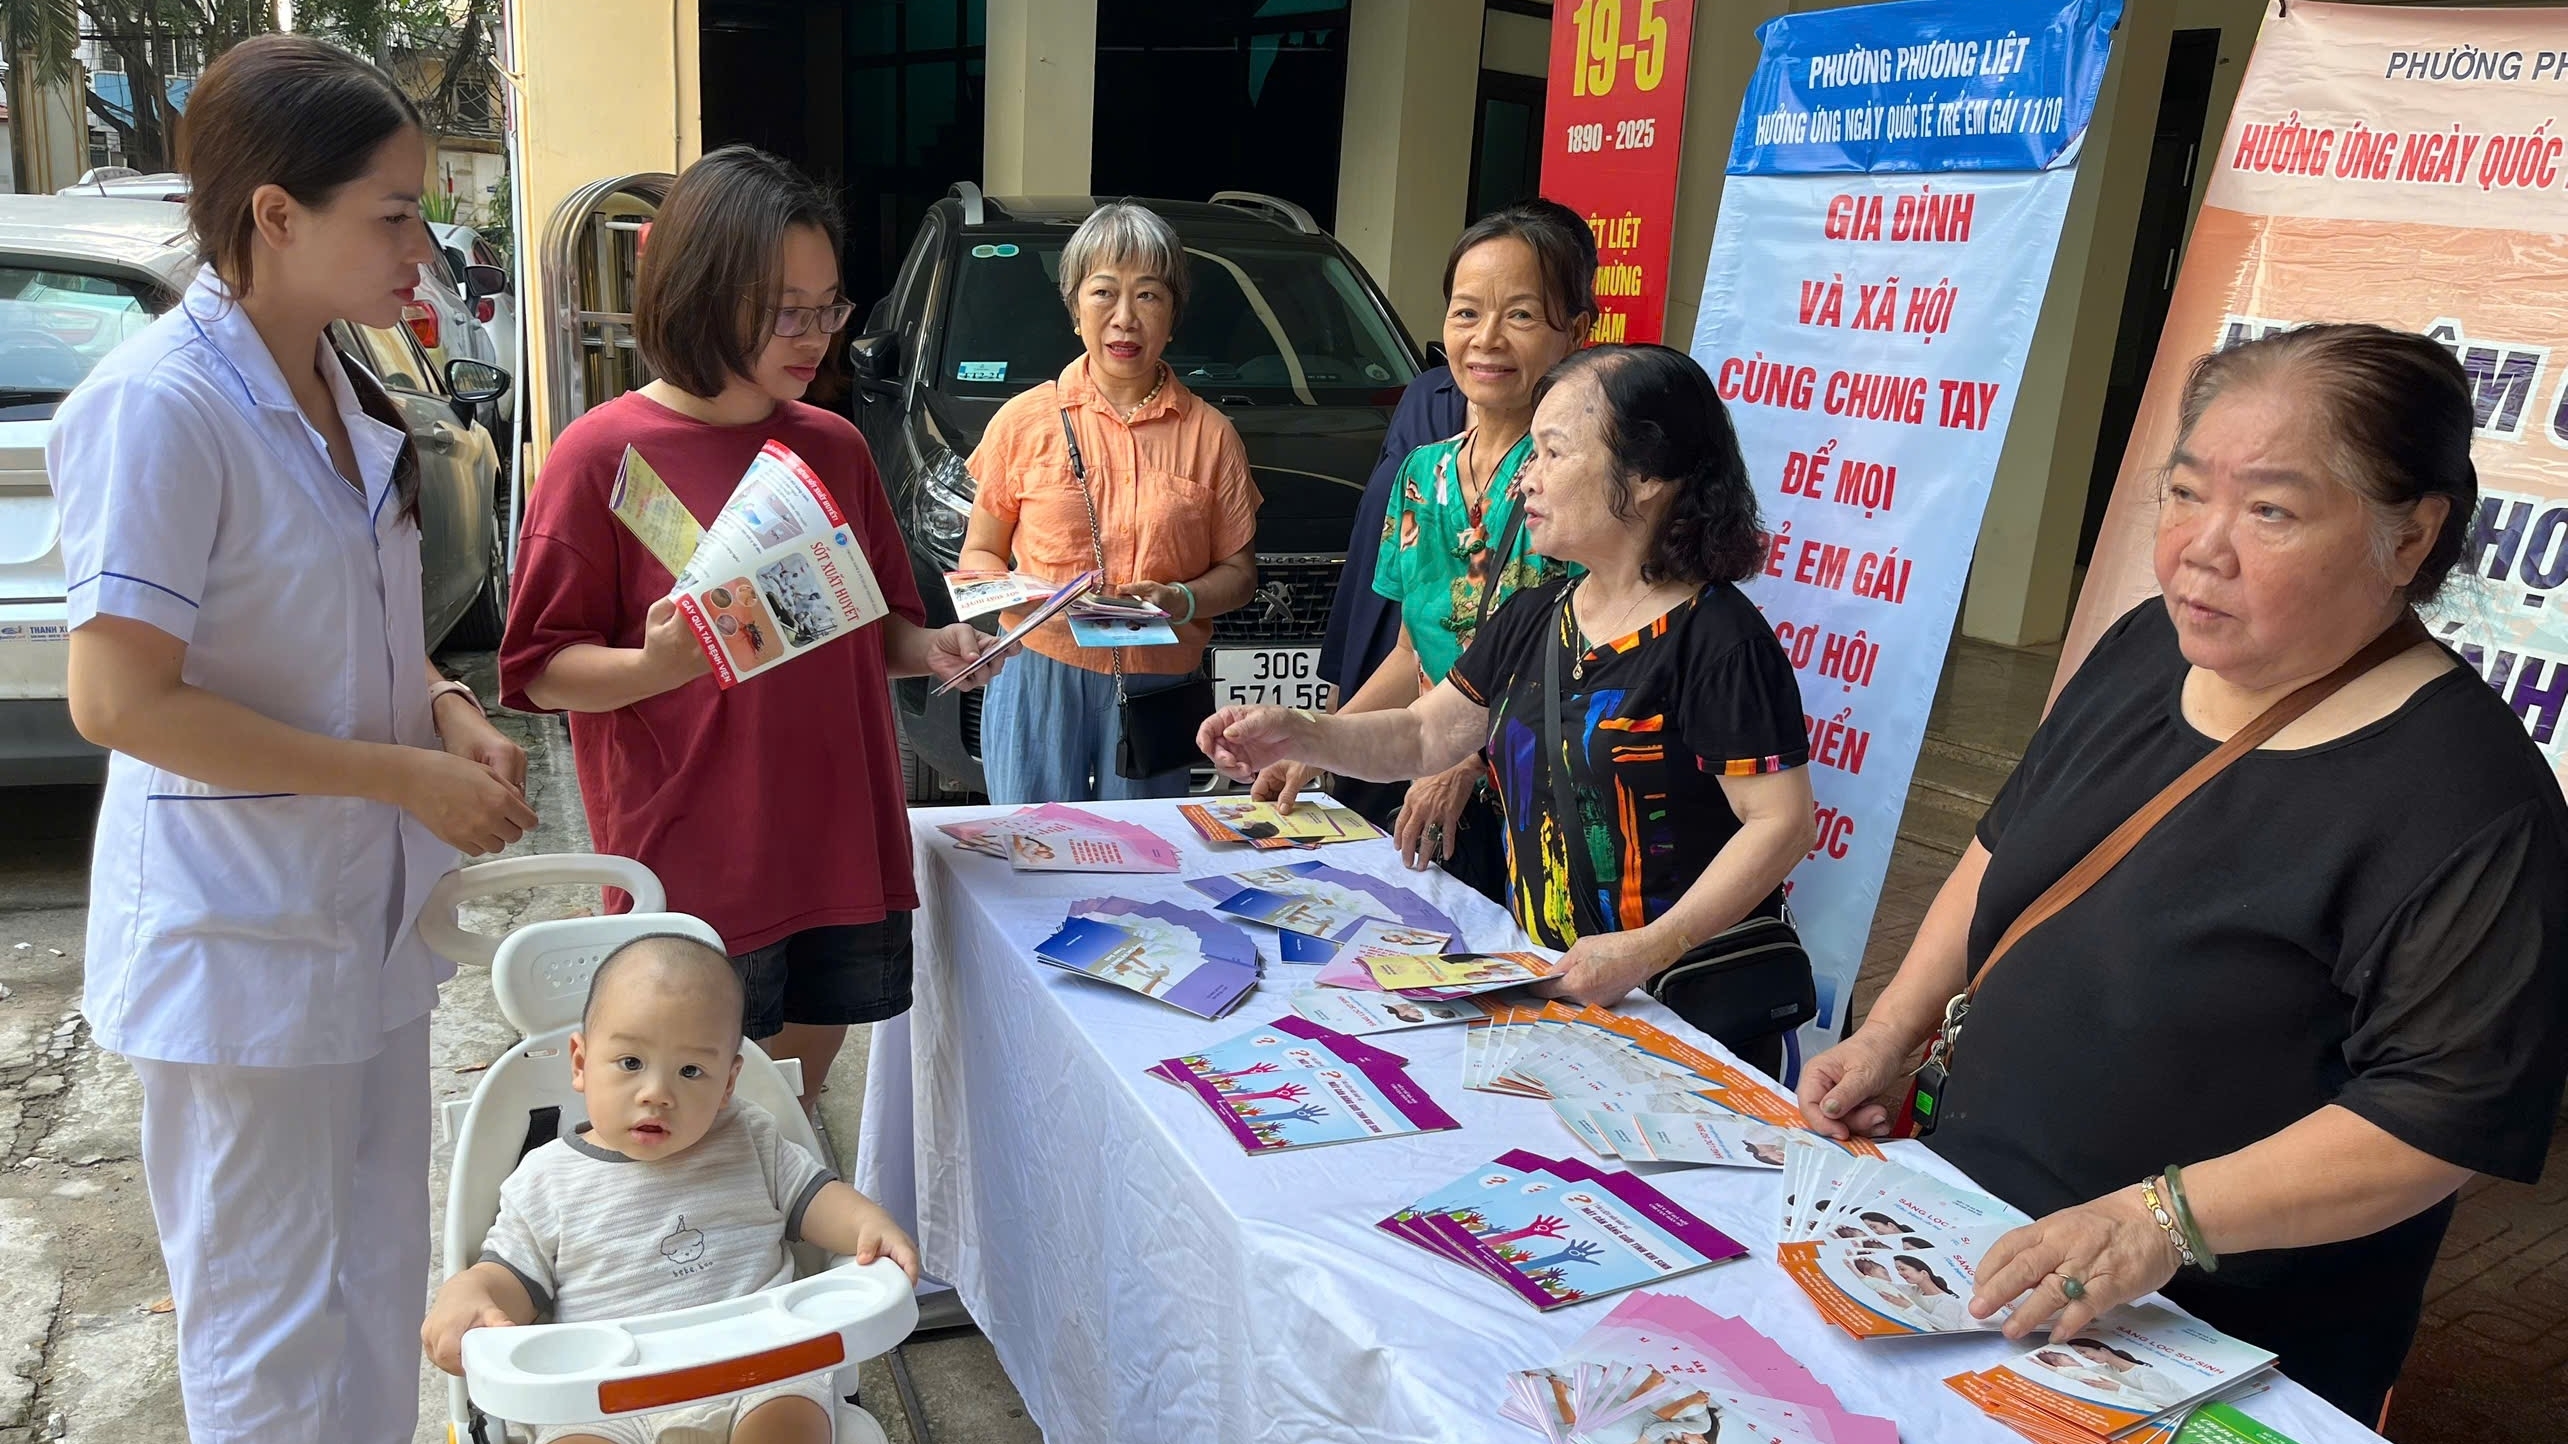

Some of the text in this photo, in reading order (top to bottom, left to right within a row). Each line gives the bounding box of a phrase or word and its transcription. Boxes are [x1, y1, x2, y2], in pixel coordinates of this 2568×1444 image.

[1573, 0, 1667, 97] 19-5
[1808, 30, 2031, 89] PHƯỜNG PHƯƠNG LIỆT
[2385, 44, 2523, 81] PHƯỜNG
[1567, 123, 1603, 153] 1890
[1615, 118, 1656, 150] 2025
[1755, 89, 2063, 146] HƯỞNG ỨNG NGÀY QUỐC TẾ TRẺ EM GÁI 11/10
[2232, 110, 2563, 191] HƯỞNG ỨNG NGÀY QUỐC
[1608, 210, 1643, 256] LIỆT
[1824, 184, 1975, 242] GIA ĐÌNH
[1595, 259, 1643, 297] MỪNG
[1799, 273, 1958, 344] VÀ XÃ HỘI
[1717, 352, 2000, 431] CÙNG CHUNG TAY
[1779, 438, 1897, 519] ĐỂ MỌI
[821, 561, 845, 588] XUẤT
[834, 588, 861, 622] HUYẾT
[1793, 540, 1851, 591] EM
[1852, 546, 1913, 604] GÁI
[707, 644, 723, 665] BỆNH
[718, 664, 732, 683] VIỆN
[1253, 652, 1309, 679] 30G
[1818, 629, 1880, 692] HỘI
[1230, 684, 1330, 710] 571.58
